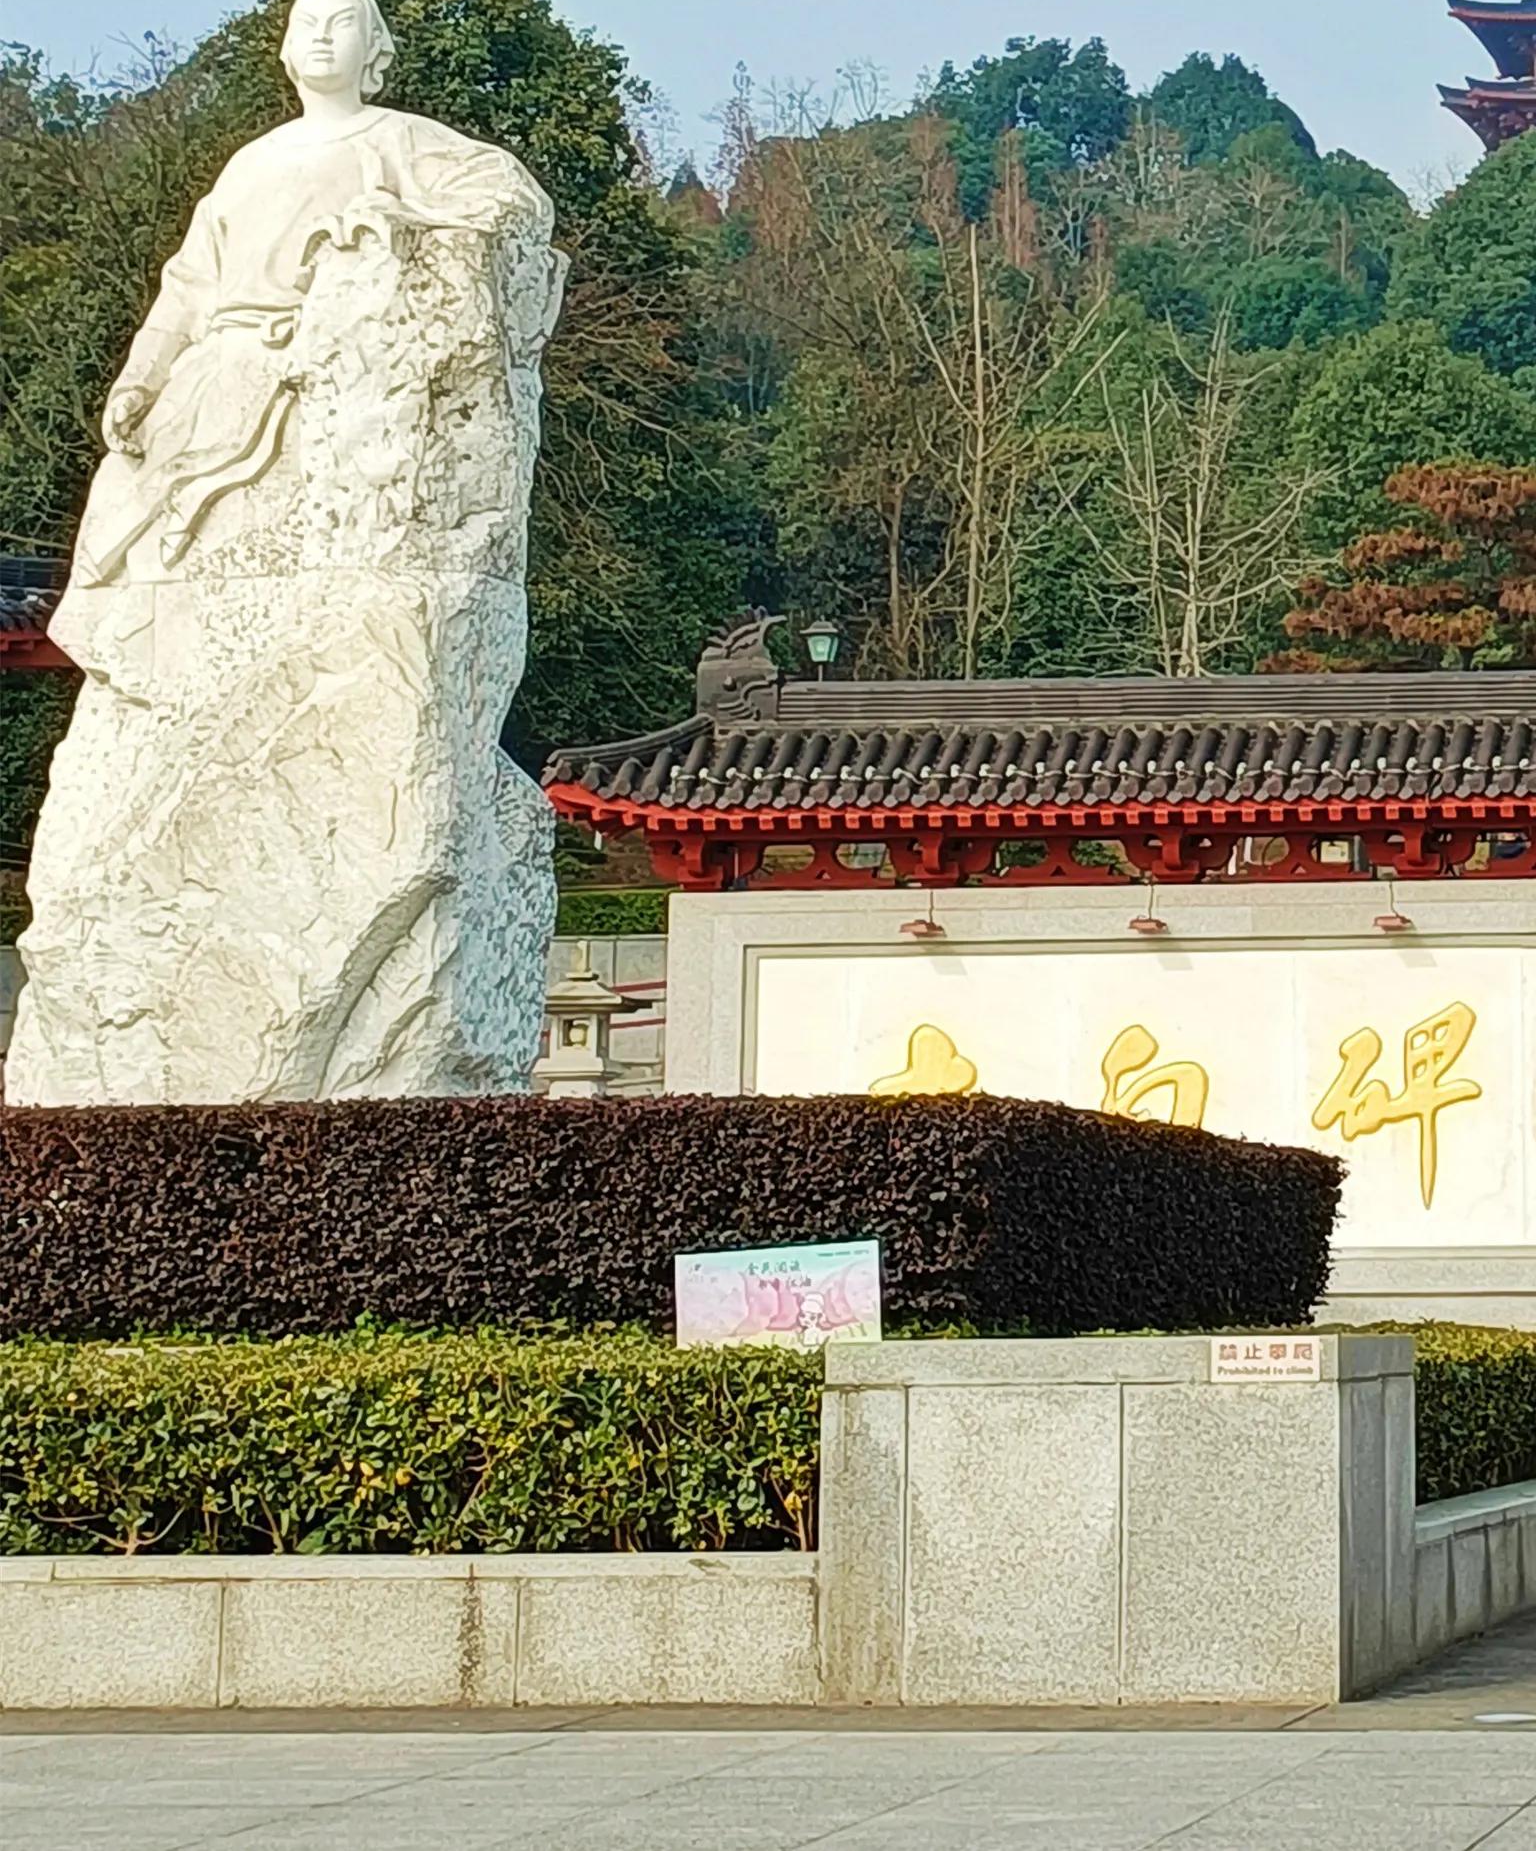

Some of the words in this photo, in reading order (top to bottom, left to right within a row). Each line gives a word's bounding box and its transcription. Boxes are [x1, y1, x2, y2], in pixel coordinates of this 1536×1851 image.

[1218, 1366, 1270, 1375] Prohibited
[1273, 1366, 1283, 1375] to
[1286, 1366, 1314, 1375] climb
